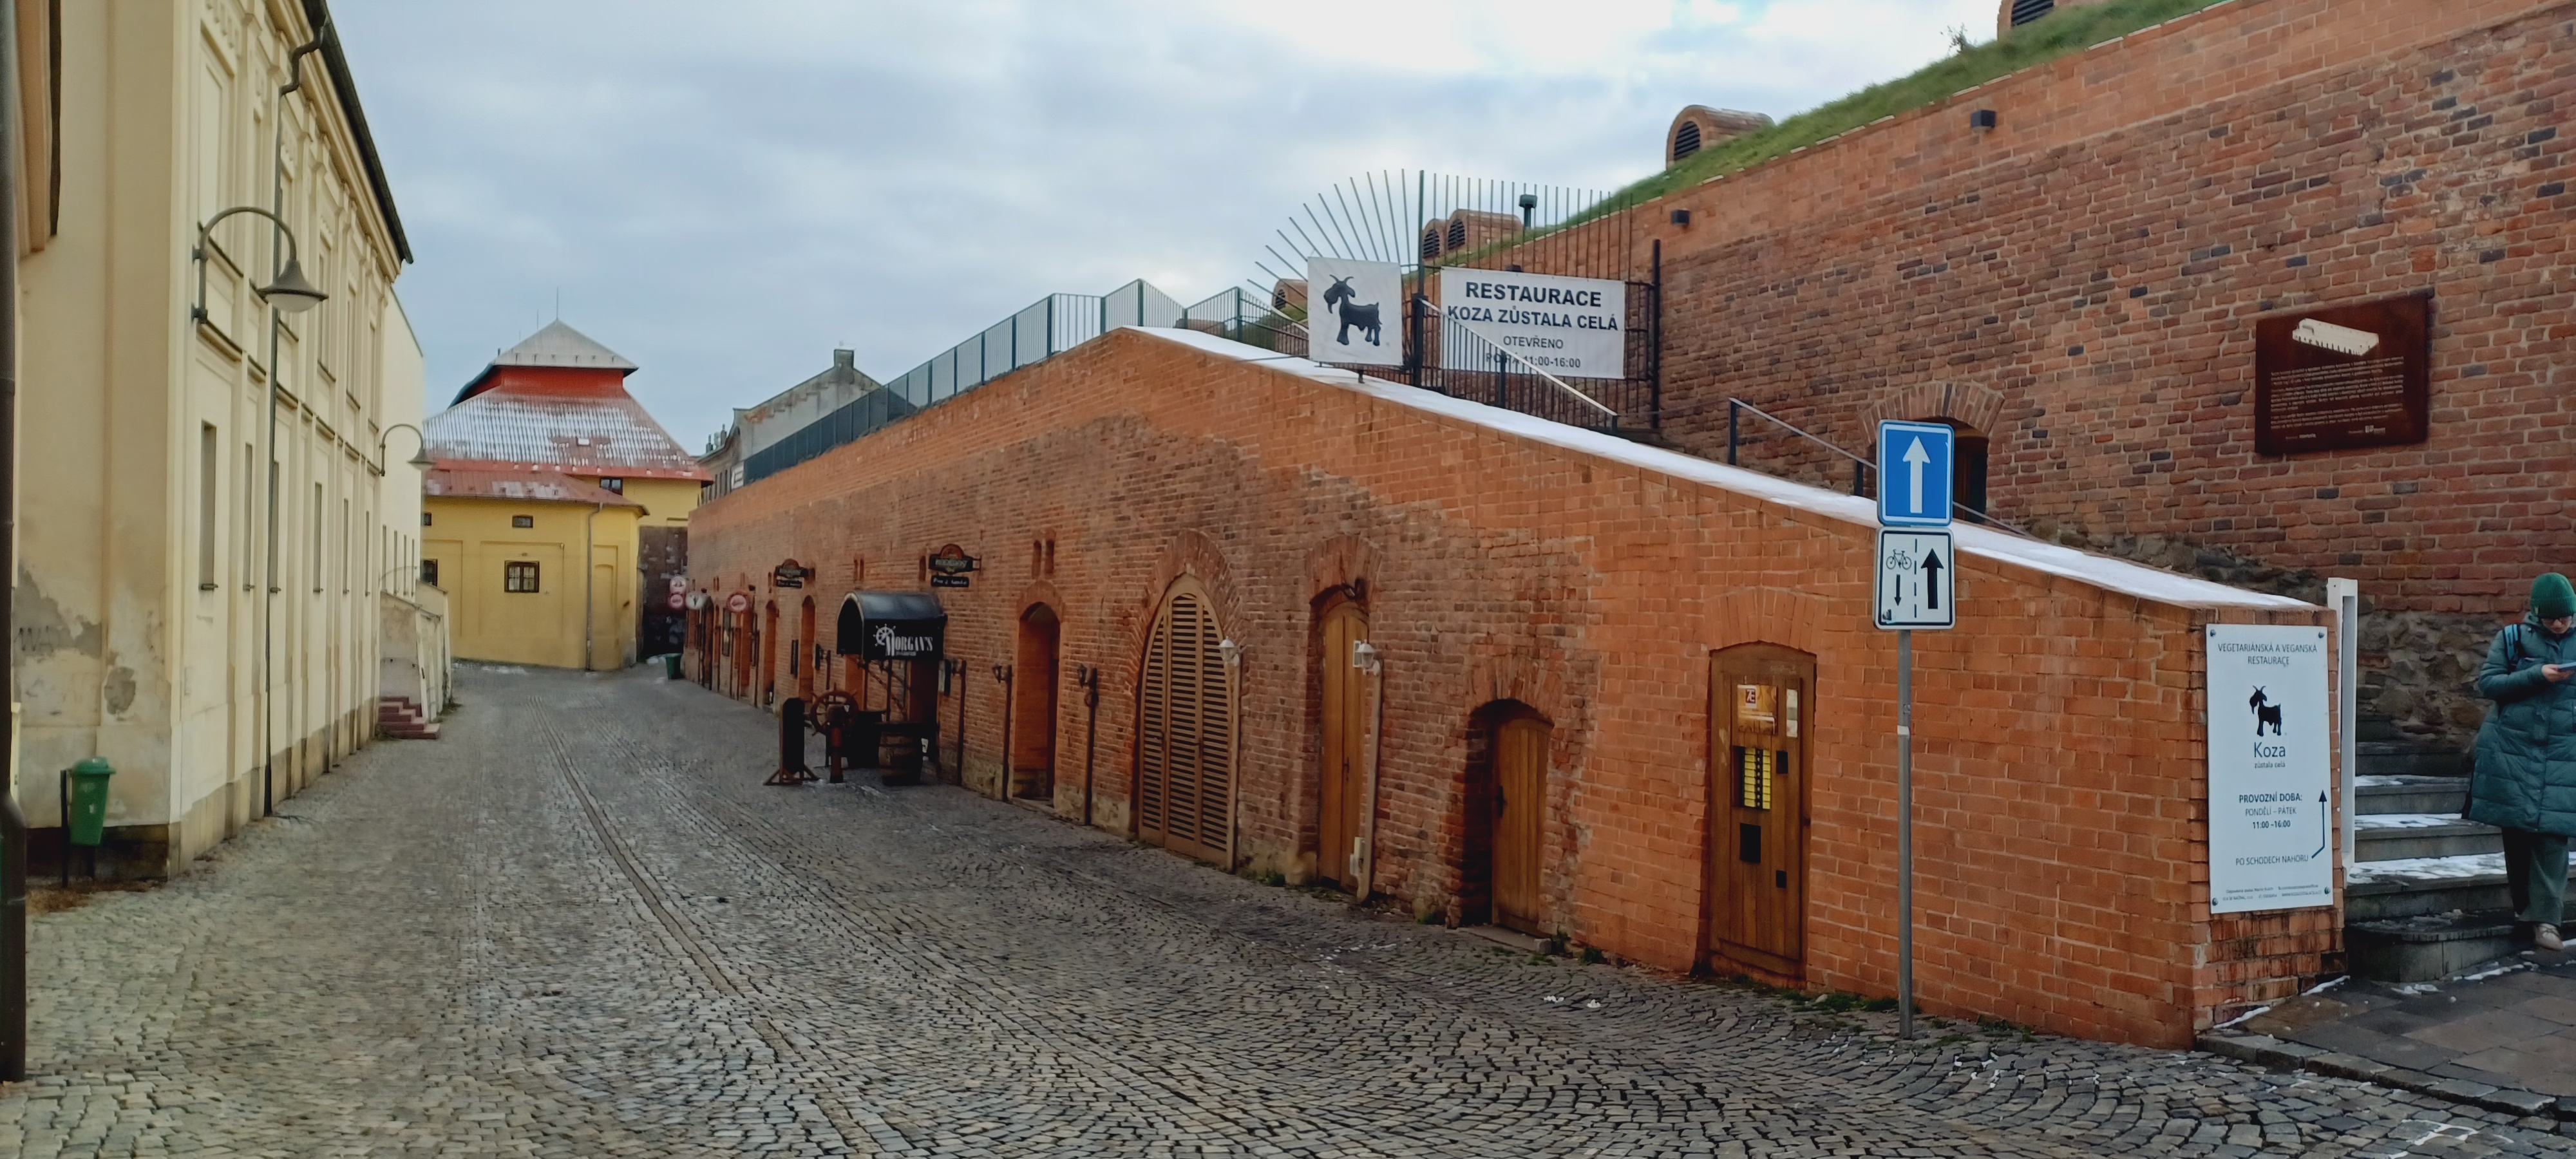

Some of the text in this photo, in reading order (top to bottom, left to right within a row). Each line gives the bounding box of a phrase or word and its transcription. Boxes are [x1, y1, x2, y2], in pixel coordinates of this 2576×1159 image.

[1466, 281, 1602, 306] RESTAURACE
[1448, 305, 1618, 330] KOZA ZŮSTALA CELÁ
[1503, 335, 1564, 348] OTEVŘENO
[2218, 642, 2273, 652] VEGETARIÁNSKÁ
[2282, 643, 2317, 653] VEGANSKÁ
[2248, 655, 2289, 665] RESTAURACE
[2254, 742, 2286, 758] Koza
[2239, 791, 2302, 803] PROVOZNÍ DOBA:
[2246, 806, 2271, 816] PONDĚLÍ
[2278, 806, 2297, 815] PÁTEK
[2246, 856, 2280, 864] SCHODECH
[2282, 854, 2309, 863] NAHORU
